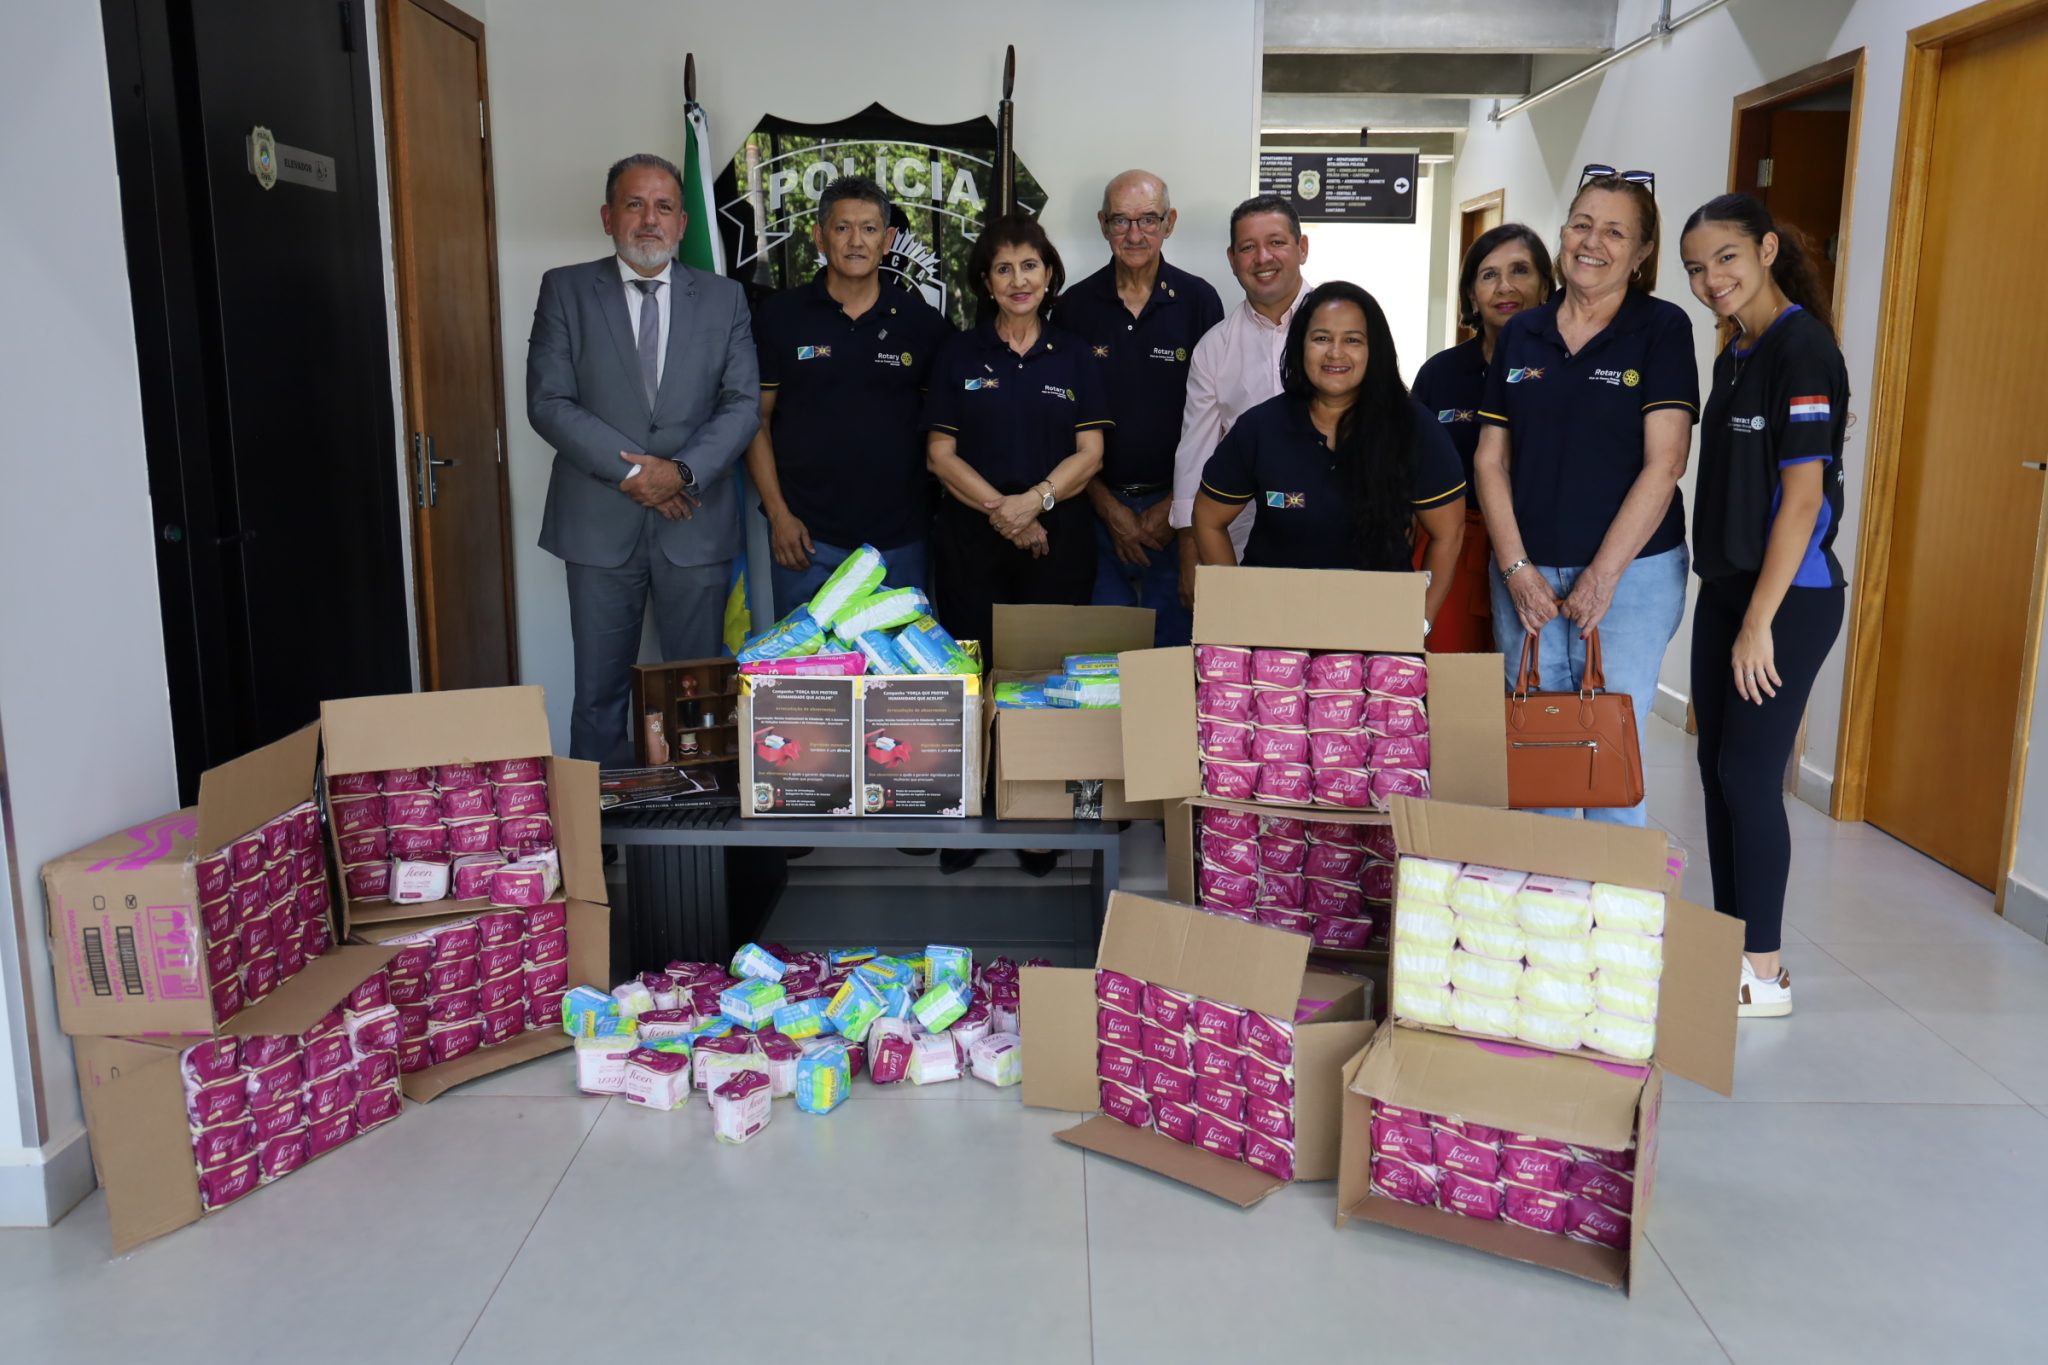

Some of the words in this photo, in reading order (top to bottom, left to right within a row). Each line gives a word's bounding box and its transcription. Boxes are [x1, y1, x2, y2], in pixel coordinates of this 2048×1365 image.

[1153, 348, 1174, 356] Rotary
[1595, 369, 1622, 378] Rotary
[1045, 384, 1066, 394] Rotary
[102, 914, 113, 955] NORMAL
